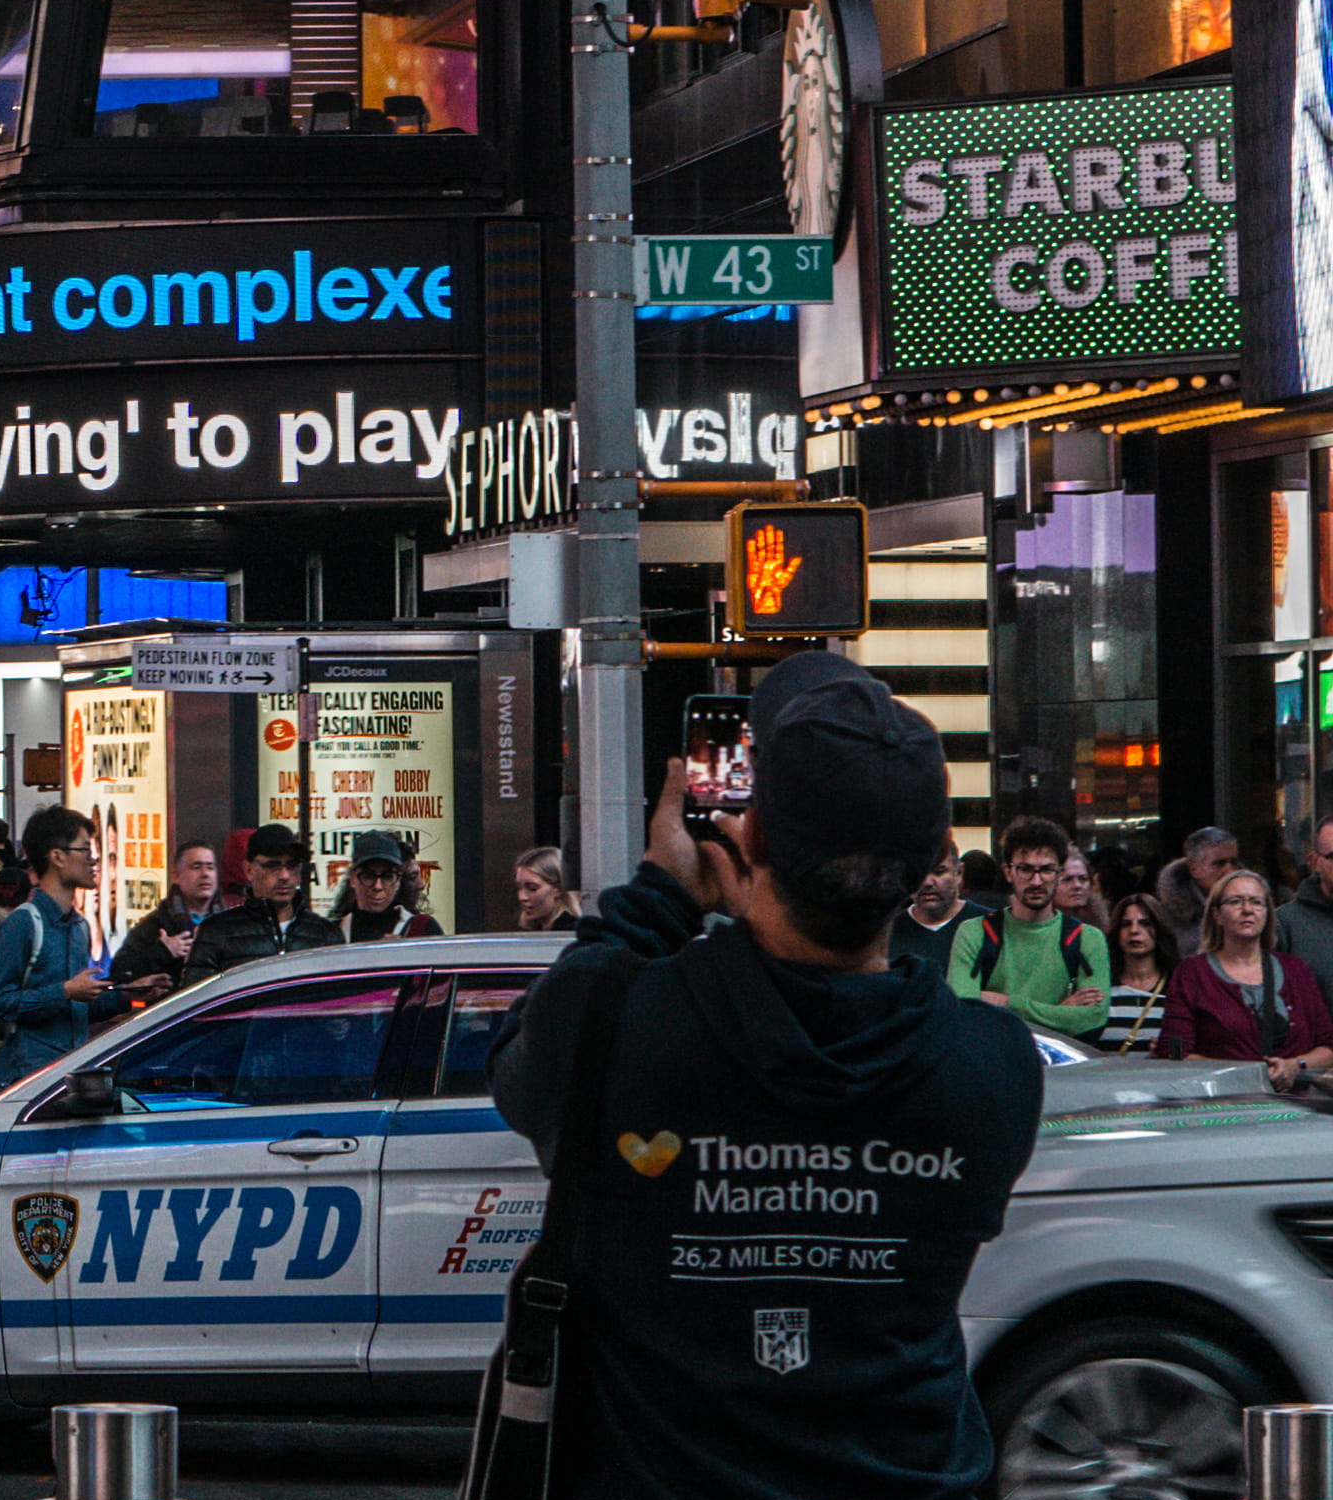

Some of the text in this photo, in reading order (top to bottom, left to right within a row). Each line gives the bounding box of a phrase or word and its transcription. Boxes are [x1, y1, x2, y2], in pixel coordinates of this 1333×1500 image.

[655, 243, 822, 295] W 43 ST
[166, 400, 251, 470] to
[277, 391, 461, 483] play
[444, 409, 579, 537] SEPHOR
[136, 650, 276, 667] PEDESTRIAN FLOW ZONE
[137, 670, 214, 686] KEEP MOVING
[324, 666, 388, 678] JCDecaux
[371, 691, 444, 711] ENGAGING
[373, 741, 379, 751] A
[380, 741, 400, 751] GOOD
[496, 674, 518, 800] Newsstand
[394, 769, 431, 793] BOBBY
[382, 795, 444, 819] CANNAVALE
[689, 1136, 966, 1181] Thomas Cook
[29, 1196, 64, 1208] POLICE
[693, 1176, 879, 1216] Marathon
[16, 1205, 75, 1222] DEPARTMENT
[79, 1185, 363, 1283] NYPD
[729, 1245, 803, 1269] MILES
[806, 1246, 843, 1268] OF
[848, 1249, 898, 1271] NYC
